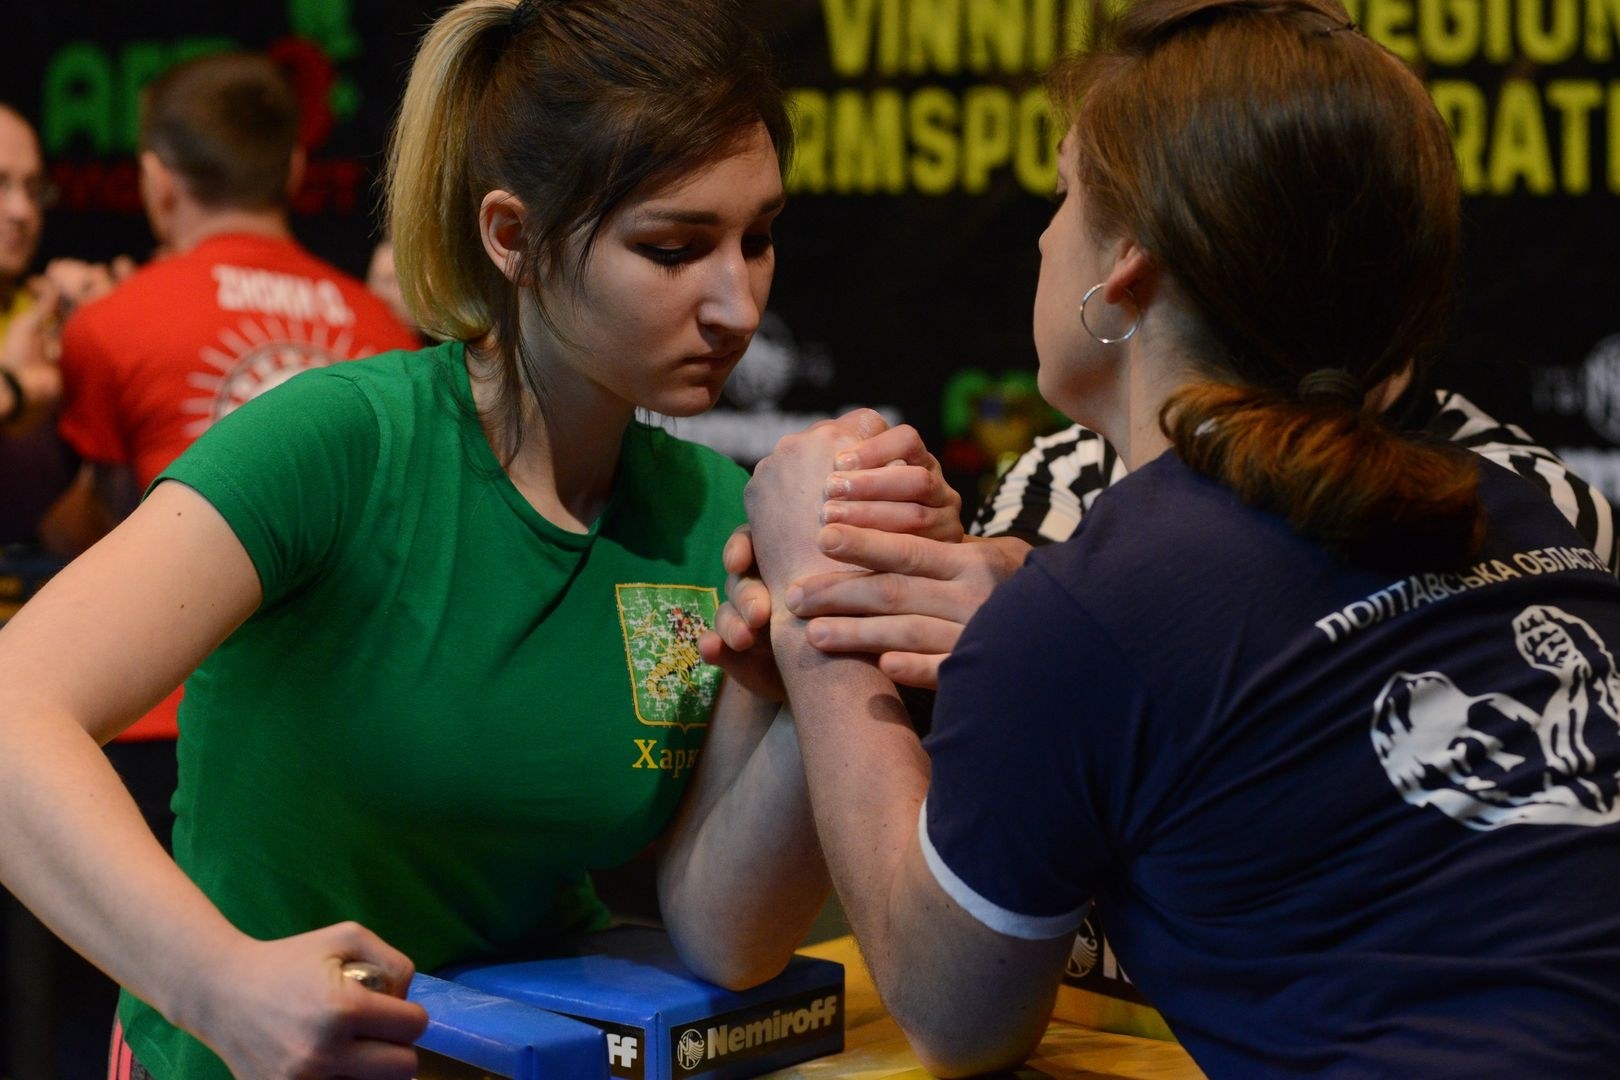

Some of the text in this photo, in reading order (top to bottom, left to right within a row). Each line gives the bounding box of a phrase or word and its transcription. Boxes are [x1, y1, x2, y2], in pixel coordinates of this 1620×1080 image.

[822, 0, 1620, 76] VINNI EGION
[782, 85, 1067, 196] RMSPO
[1512, 546, 1612, 576] ОБЛАСТ
[632, 738, 705, 779] Харк
[606, 1033, 638, 1068] ff
[707, 995, 837, 1061] Nemiroff
